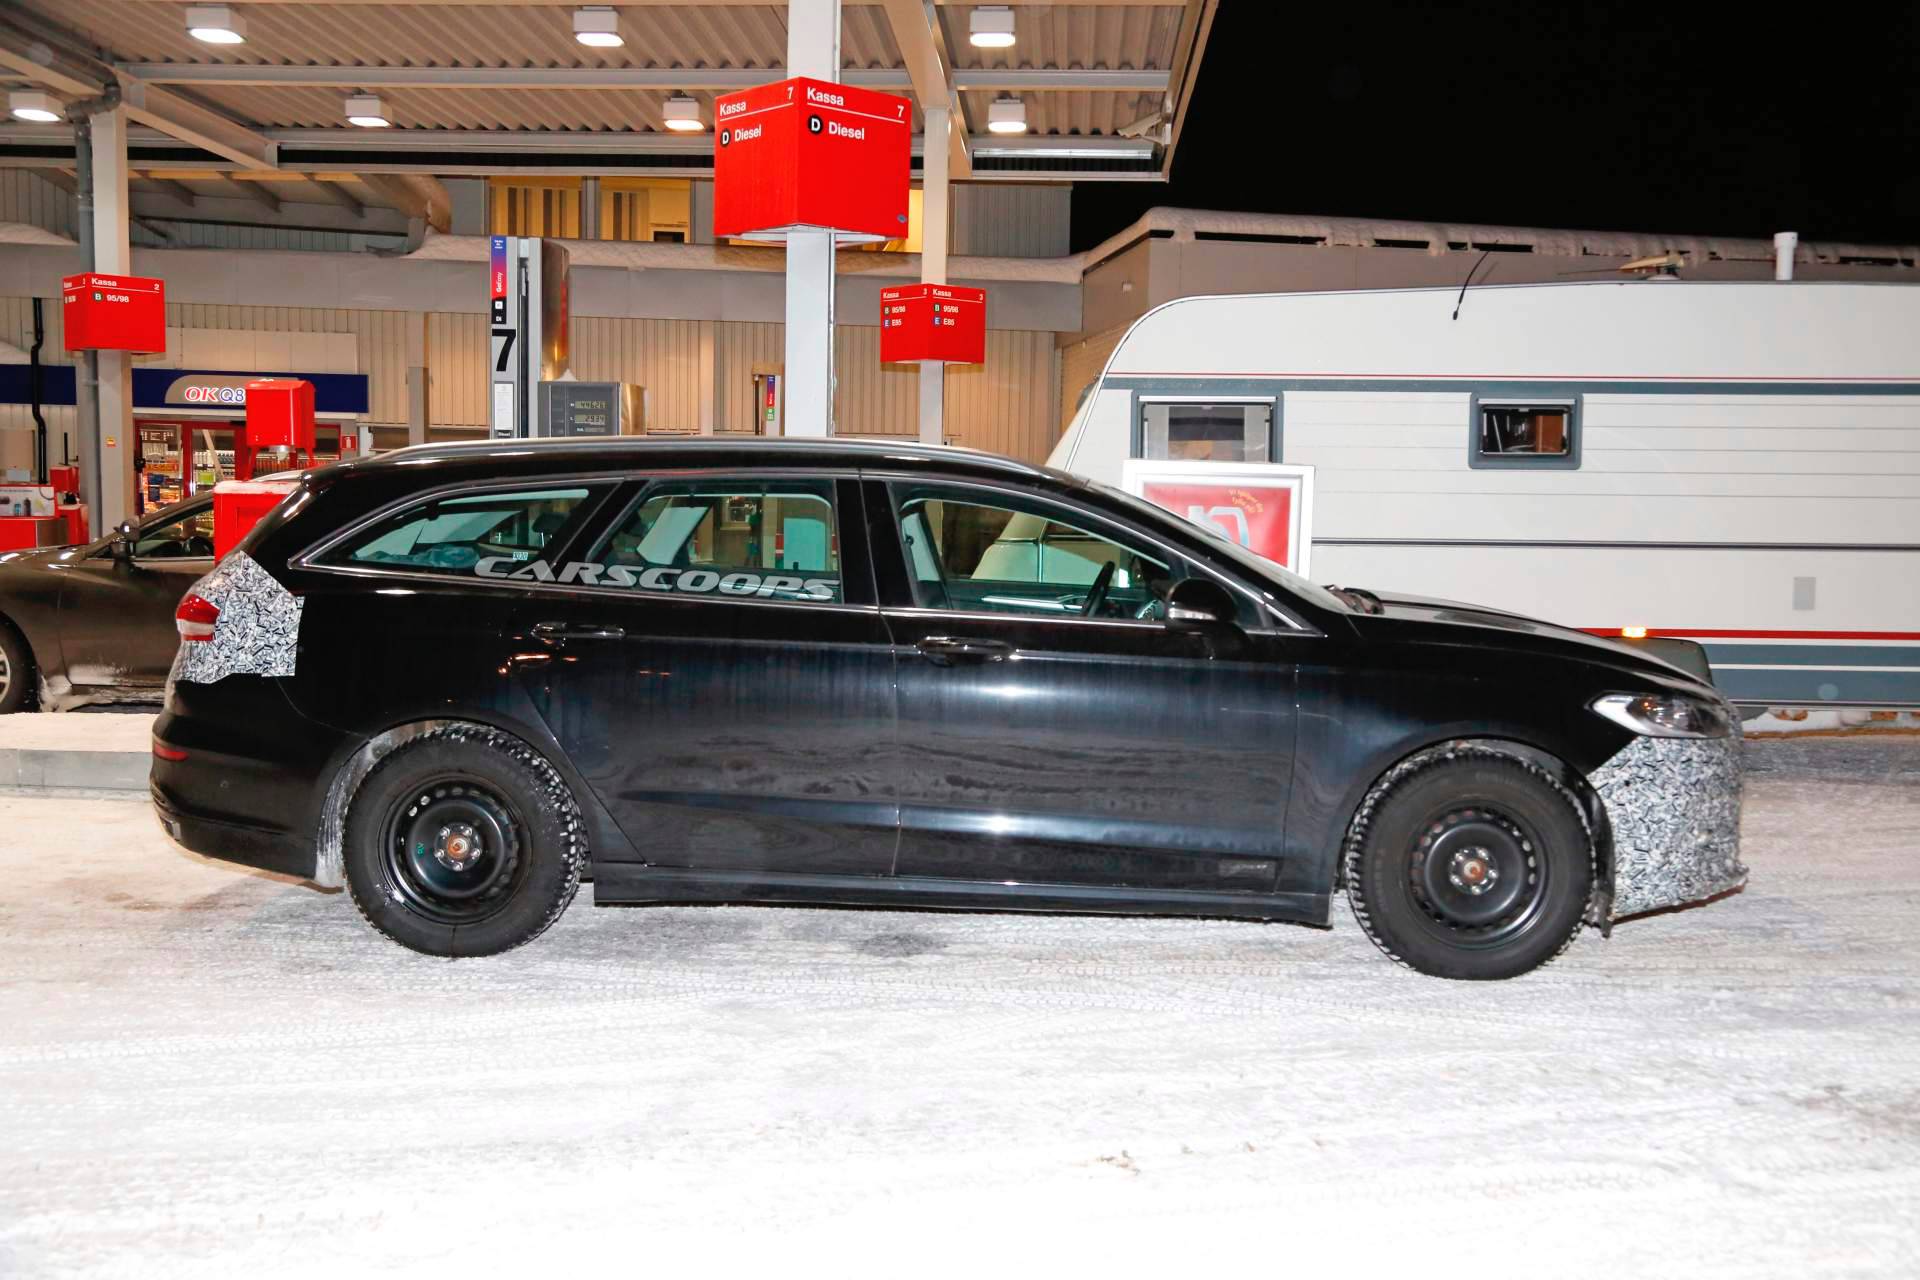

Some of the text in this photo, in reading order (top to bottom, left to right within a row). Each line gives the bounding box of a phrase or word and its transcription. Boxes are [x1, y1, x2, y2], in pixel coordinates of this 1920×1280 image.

[719, 86, 794, 116] Kassa 7
[807, 87, 904, 118] Kassa 7
[722, 125, 762, 145] D Diesel
[811, 118, 865, 141] D Diesel
[91, 278, 117, 287] Kassa
[154, 283, 160, 291] 2
[932, 289, 952, 298] Kassa
[94, 293, 130, 303] B 95/98
[492, 329, 516, 371] 7
[185, 386, 246, 403] OKQ8
